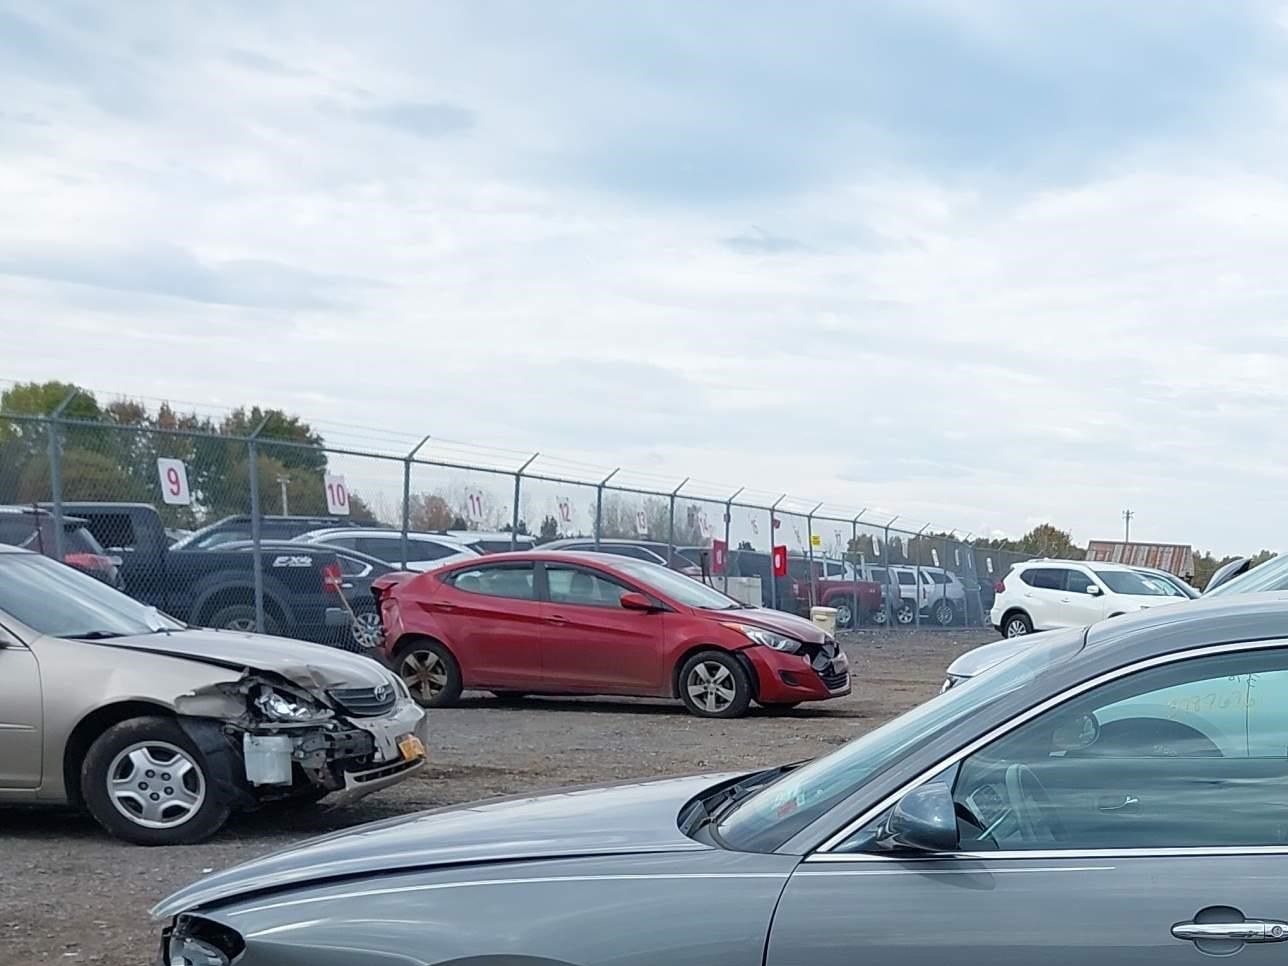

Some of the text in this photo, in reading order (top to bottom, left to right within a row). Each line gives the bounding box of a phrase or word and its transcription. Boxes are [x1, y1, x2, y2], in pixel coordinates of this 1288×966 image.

[166, 467, 181, 496] 9
[327, 483, 346, 507] 10
[469, 494, 482, 518] 11
[559, 503, 571, 522] 12
